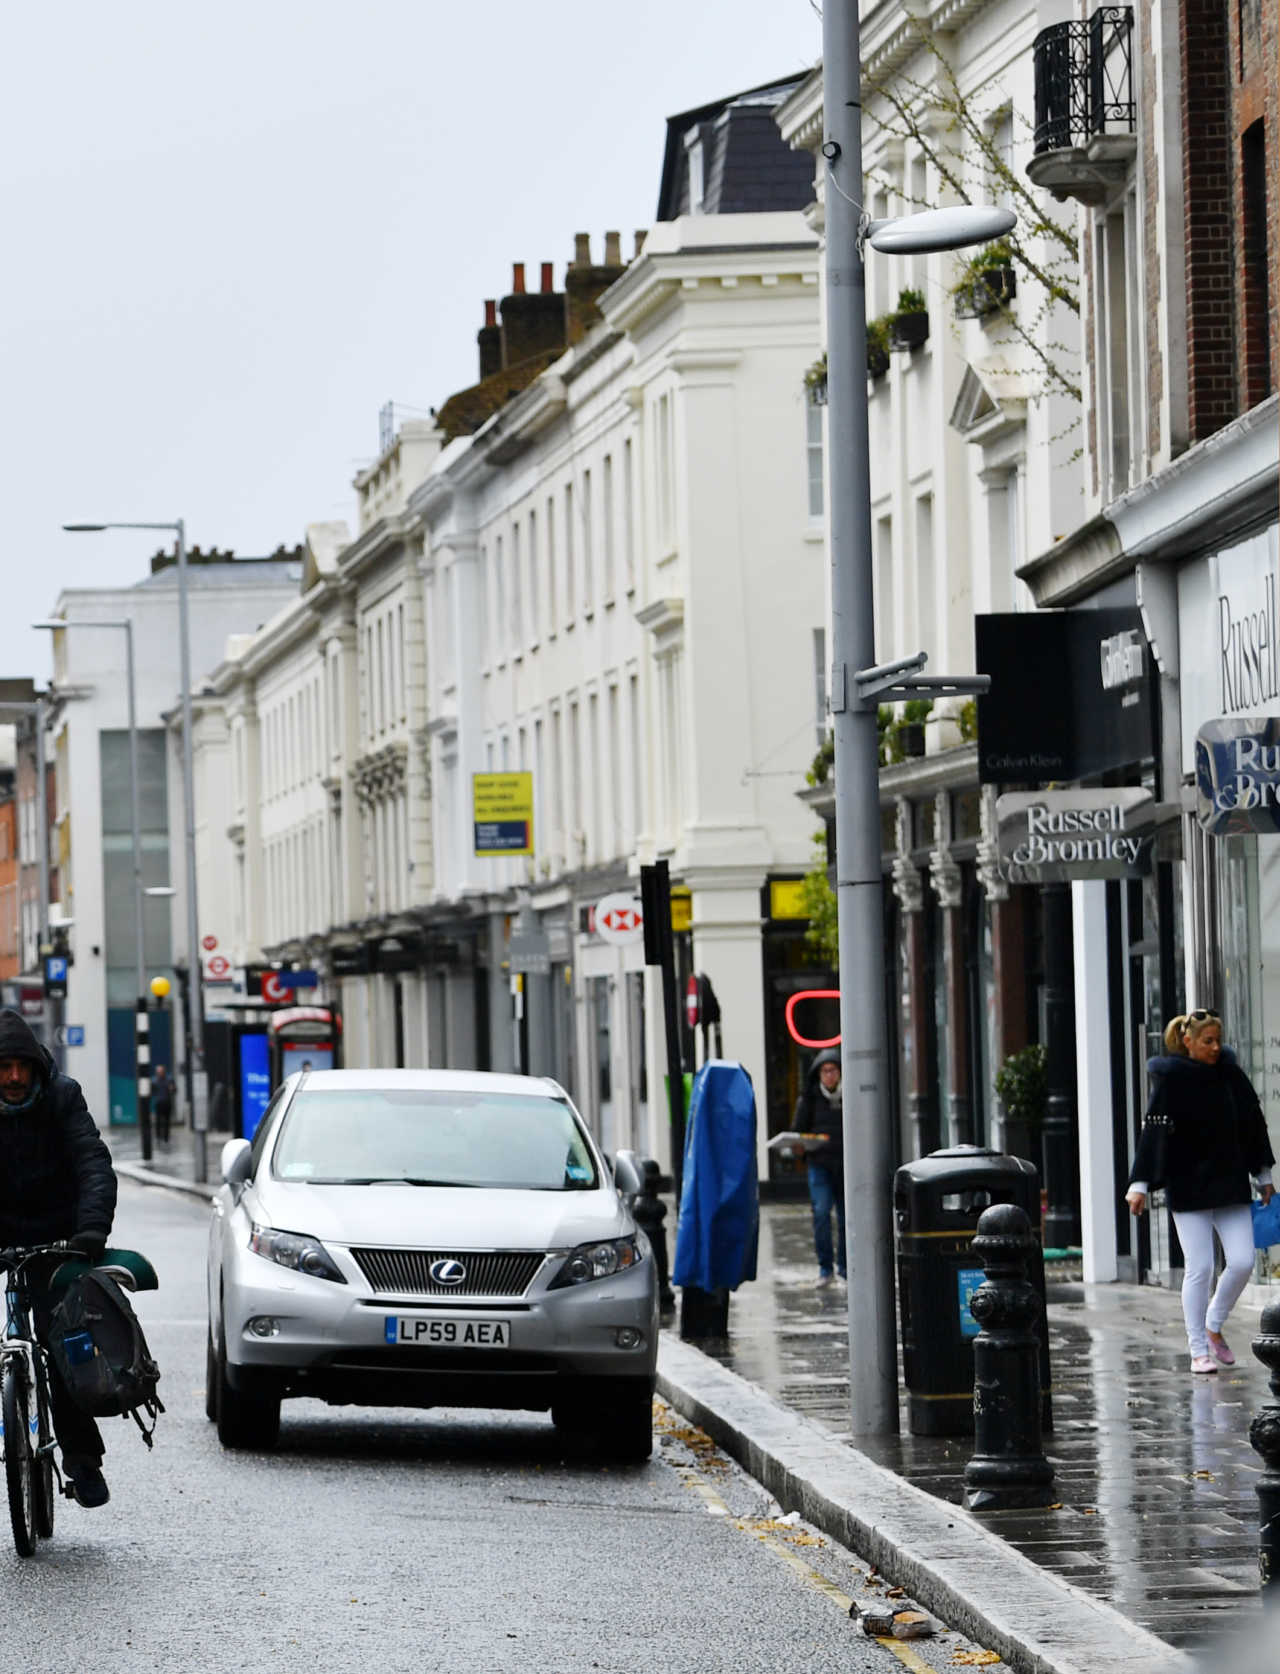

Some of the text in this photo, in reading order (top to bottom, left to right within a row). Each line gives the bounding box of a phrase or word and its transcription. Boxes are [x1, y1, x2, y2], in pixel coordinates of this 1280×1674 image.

[1219, 573, 1278, 715] Russell
[1026, 804, 1125, 834] Russell
[400, 1320, 505, 1344] LP59 AEA
